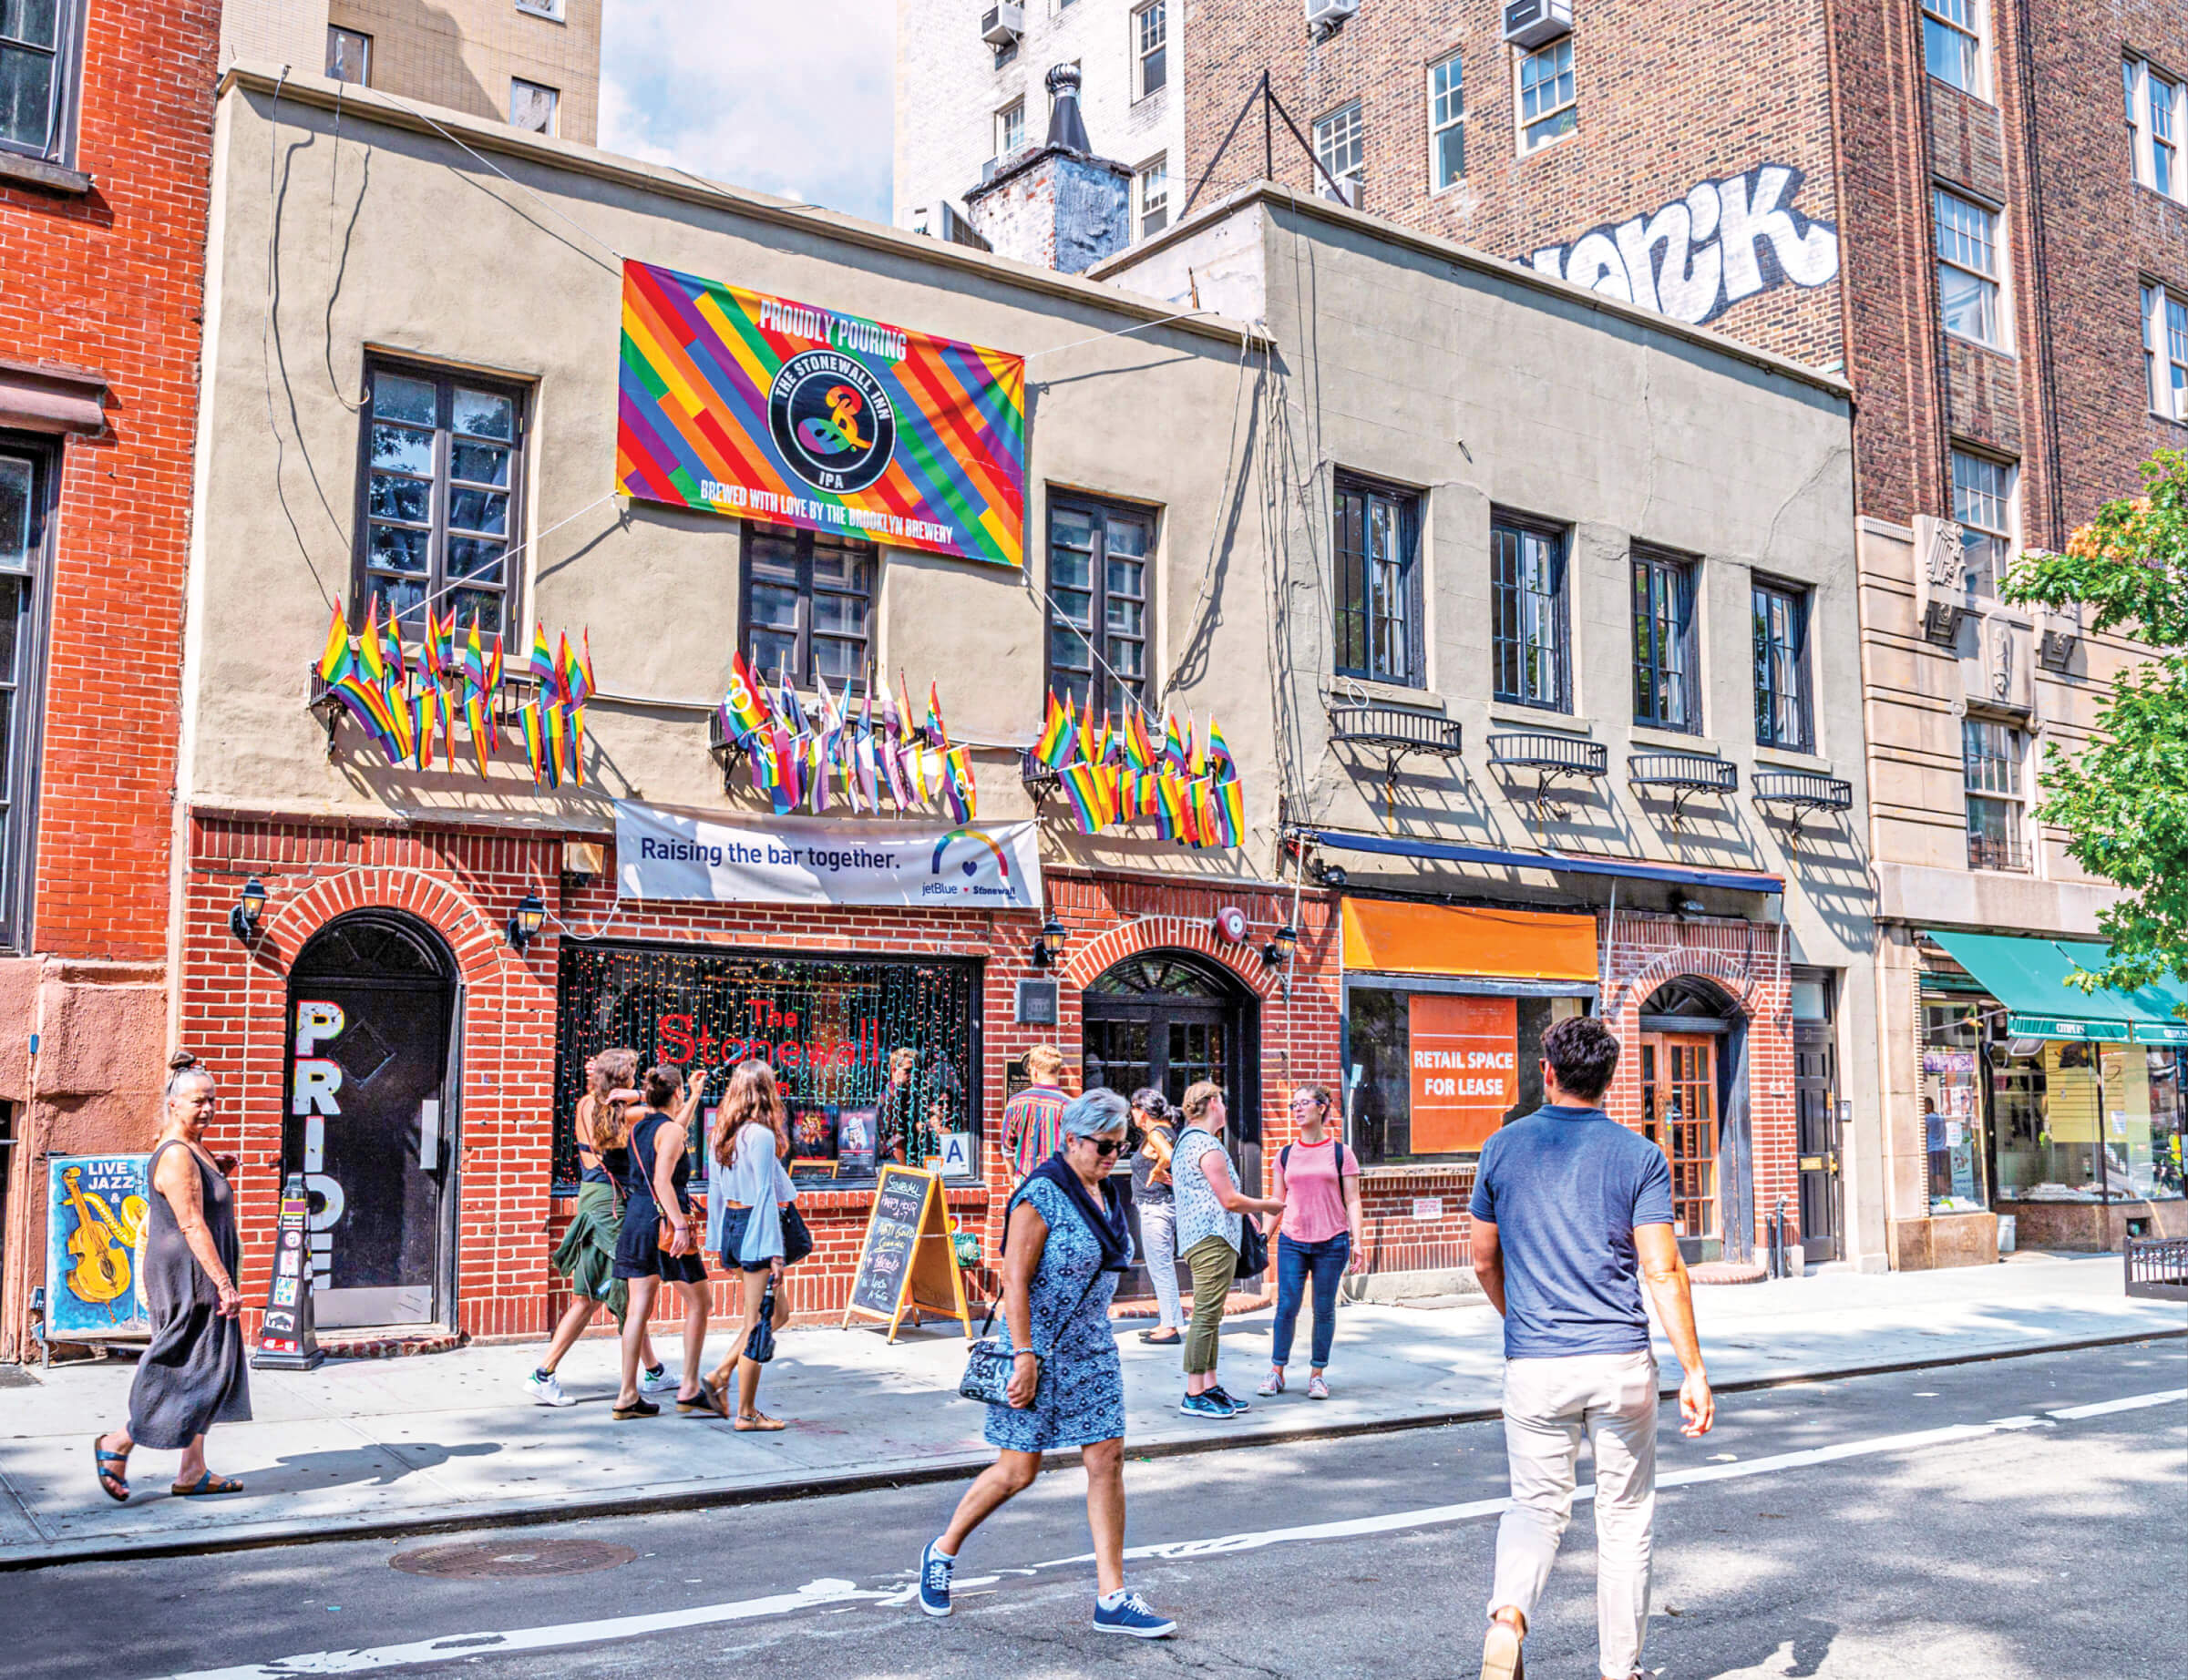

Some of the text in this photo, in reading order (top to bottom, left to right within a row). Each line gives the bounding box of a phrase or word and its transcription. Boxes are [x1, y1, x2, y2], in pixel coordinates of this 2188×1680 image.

[760, 299, 908, 362] PROUDLY POURING
[775, 355, 890, 420] THE STONEWALL INN
[818, 471, 844, 489] IPA
[701, 479, 953, 545] BREWED WITH LOVE BY THE BROOKLYN BREWERY
[641, 837, 900, 872] Raising the bar together.
[921, 882, 1016, 897] jetBlue Stonewall
[745, 999, 798, 1028] The
[657, 1013, 878, 1067] Stonewall
[1413, 1050, 1515, 1070] RETAIL SPACE
[1424, 1078, 1504, 1096] FOR LEASE
[292, 999, 345, 1290] PRIDE
[946, 1139, 964, 1163] A
[87, 1162, 128, 1175] LIVE
[88, 1176, 136, 1190] JAZZ
[110, 1193, 121, 1204] &
